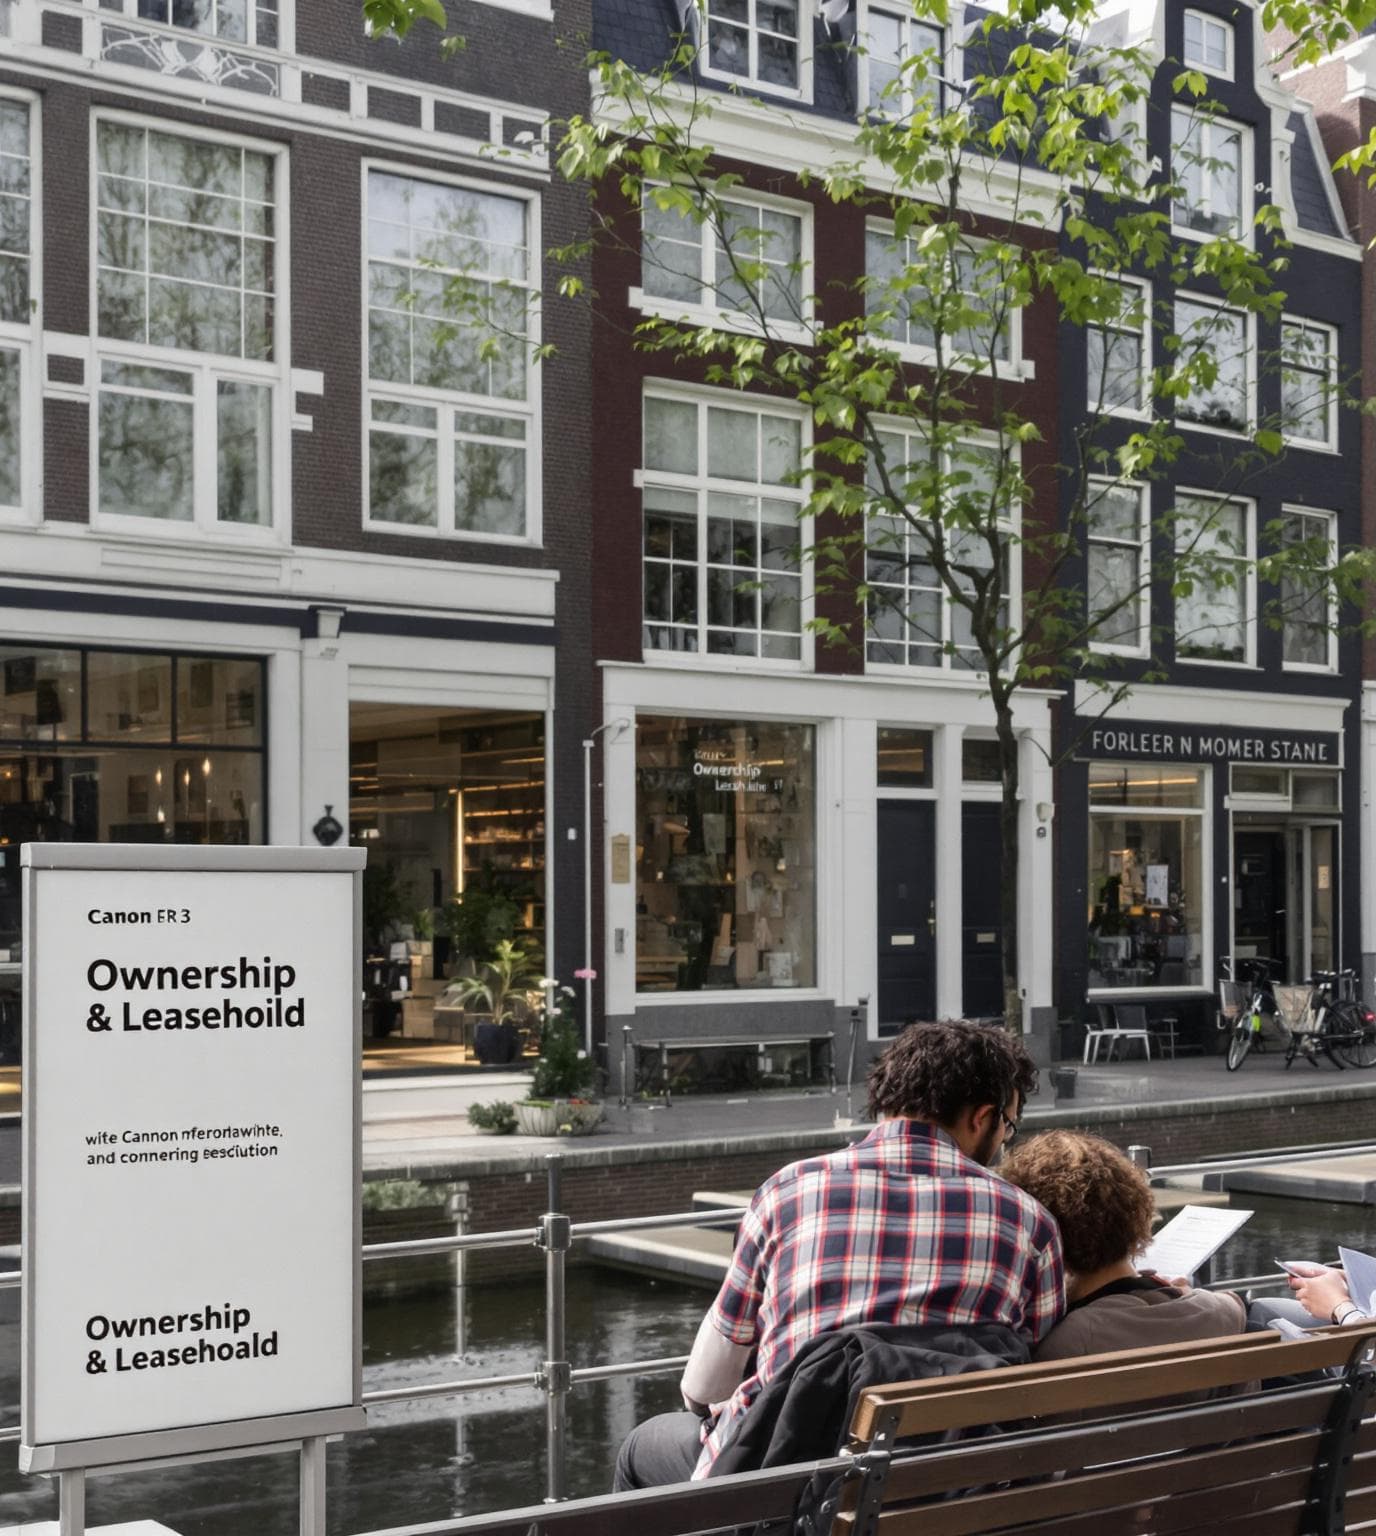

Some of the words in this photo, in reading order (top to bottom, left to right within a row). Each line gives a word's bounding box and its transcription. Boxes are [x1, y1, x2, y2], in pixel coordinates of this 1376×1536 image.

[1092, 730, 1174, 753] FORLEER
[1180, 736, 1192, 754] N
[1199, 737, 1265, 758] MOMER
[87, 908, 152, 925] Canon
[180, 908, 191, 924] 3
[86, 955, 297, 996] Ownership
[86, 1002, 113, 1033] &
[122, 997, 306, 1033] Leasehoild
[121, 1130, 179, 1144] Cannon
[86, 1151, 116, 1166] and
[119, 1146, 199, 1164] connering
[85, 1302, 251, 1341] Ownership
[85, 1349, 108, 1375] &
[115, 1330, 279, 1372] Leasehoald
